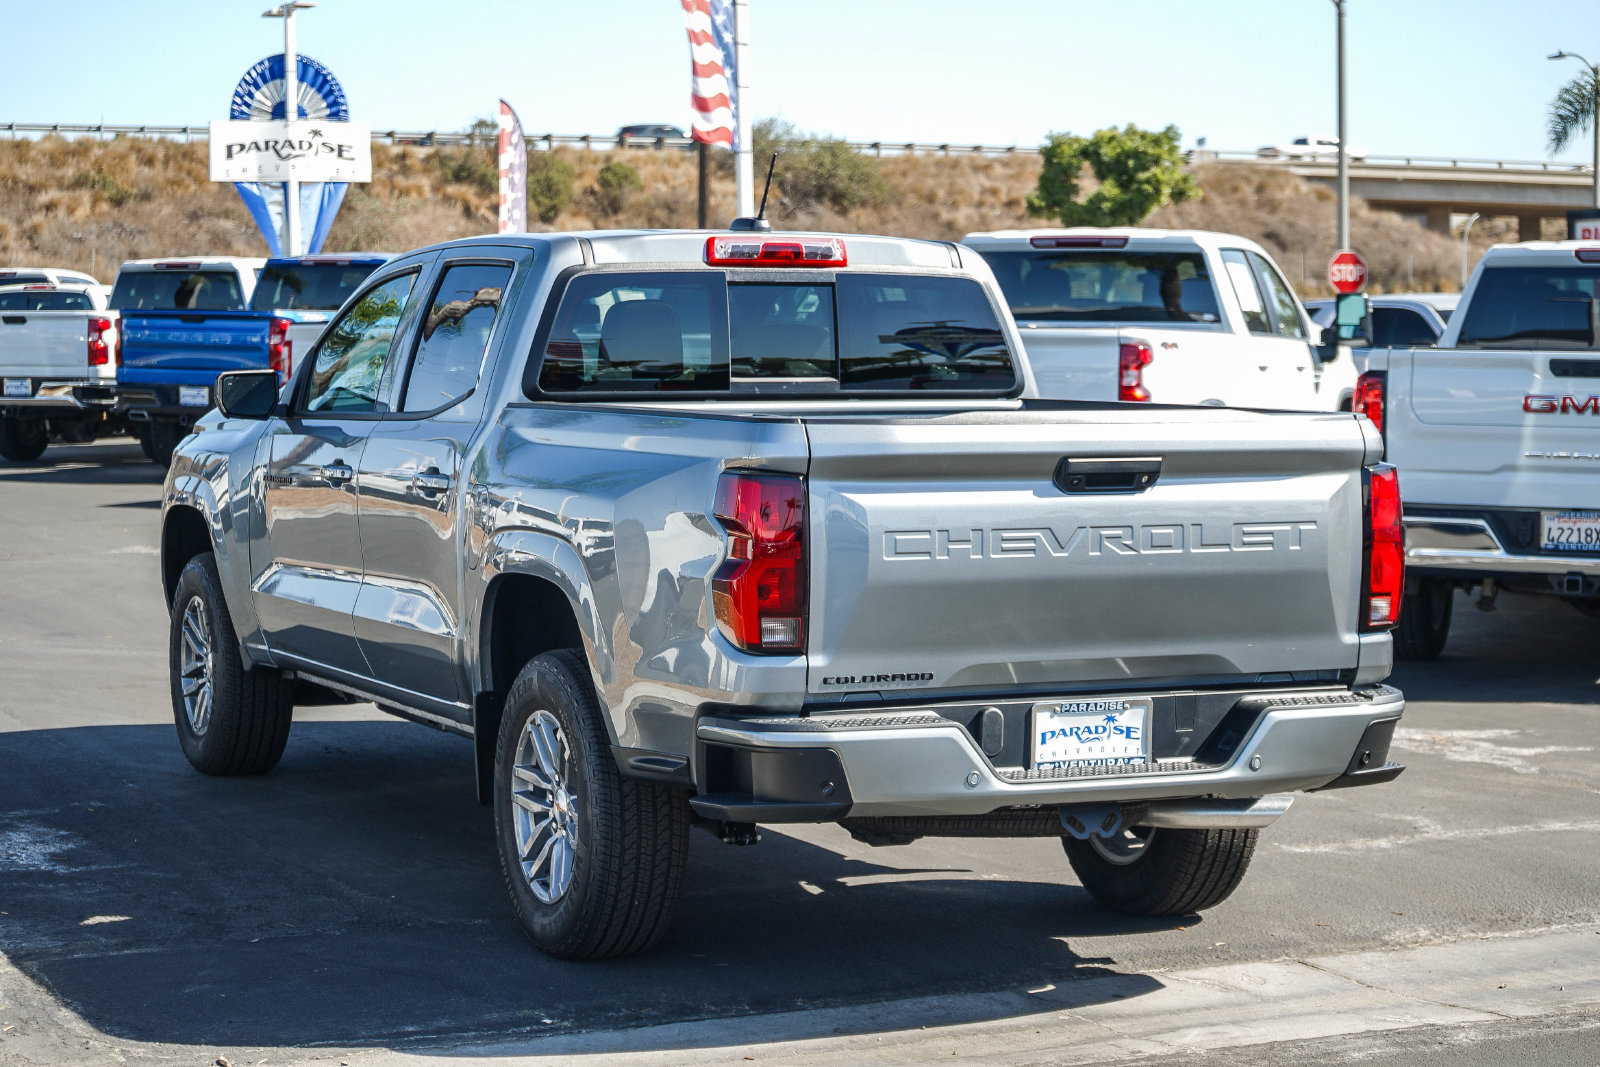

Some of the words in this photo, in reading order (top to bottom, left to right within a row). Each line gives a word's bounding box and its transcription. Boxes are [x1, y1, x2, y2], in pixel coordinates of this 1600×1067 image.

[226, 131, 355, 160] PARADISE
[1332, 263, 1365, 282] STOP
[882, 520, 1318, 561] CHEVROLET
[822, 672, 934, 685] COLORADO
[1061, 702, 1124, 713] PARADISE
[1041, 714, 1140, 745] PARADISE
[1039, 746, 1140, 760] CHEVROLET
